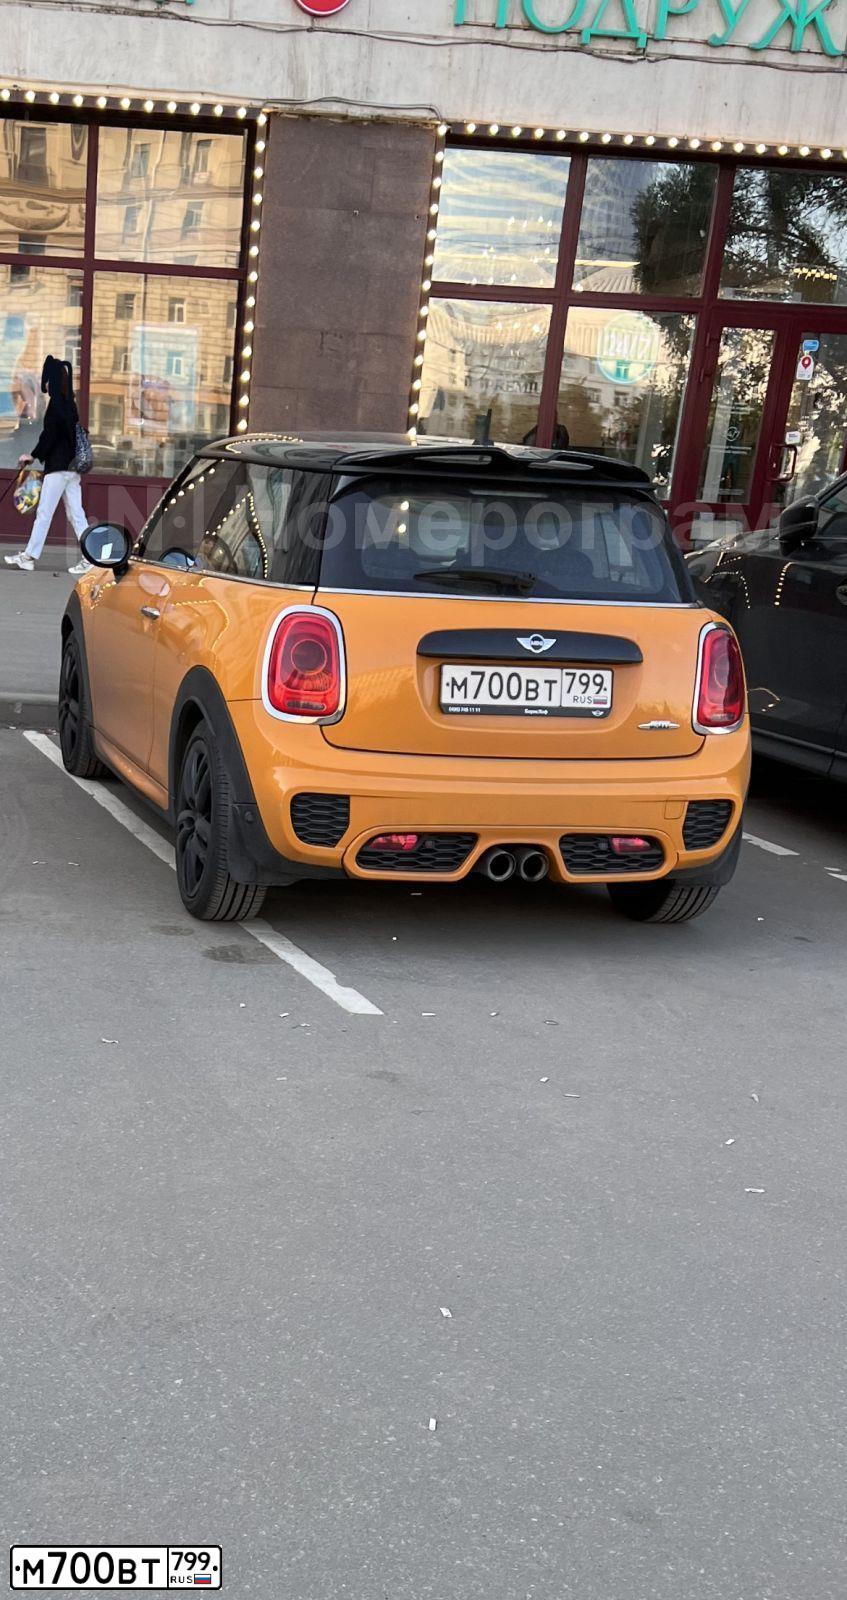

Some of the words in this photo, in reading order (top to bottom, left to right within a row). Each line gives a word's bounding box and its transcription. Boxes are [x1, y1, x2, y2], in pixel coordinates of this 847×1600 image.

[602, 332, 652, 358] 24/7
[450, 671, 558, 702] М700ВТ
[565, 672, 604, 695] 799
[573, 695, 592, 703] RUS
